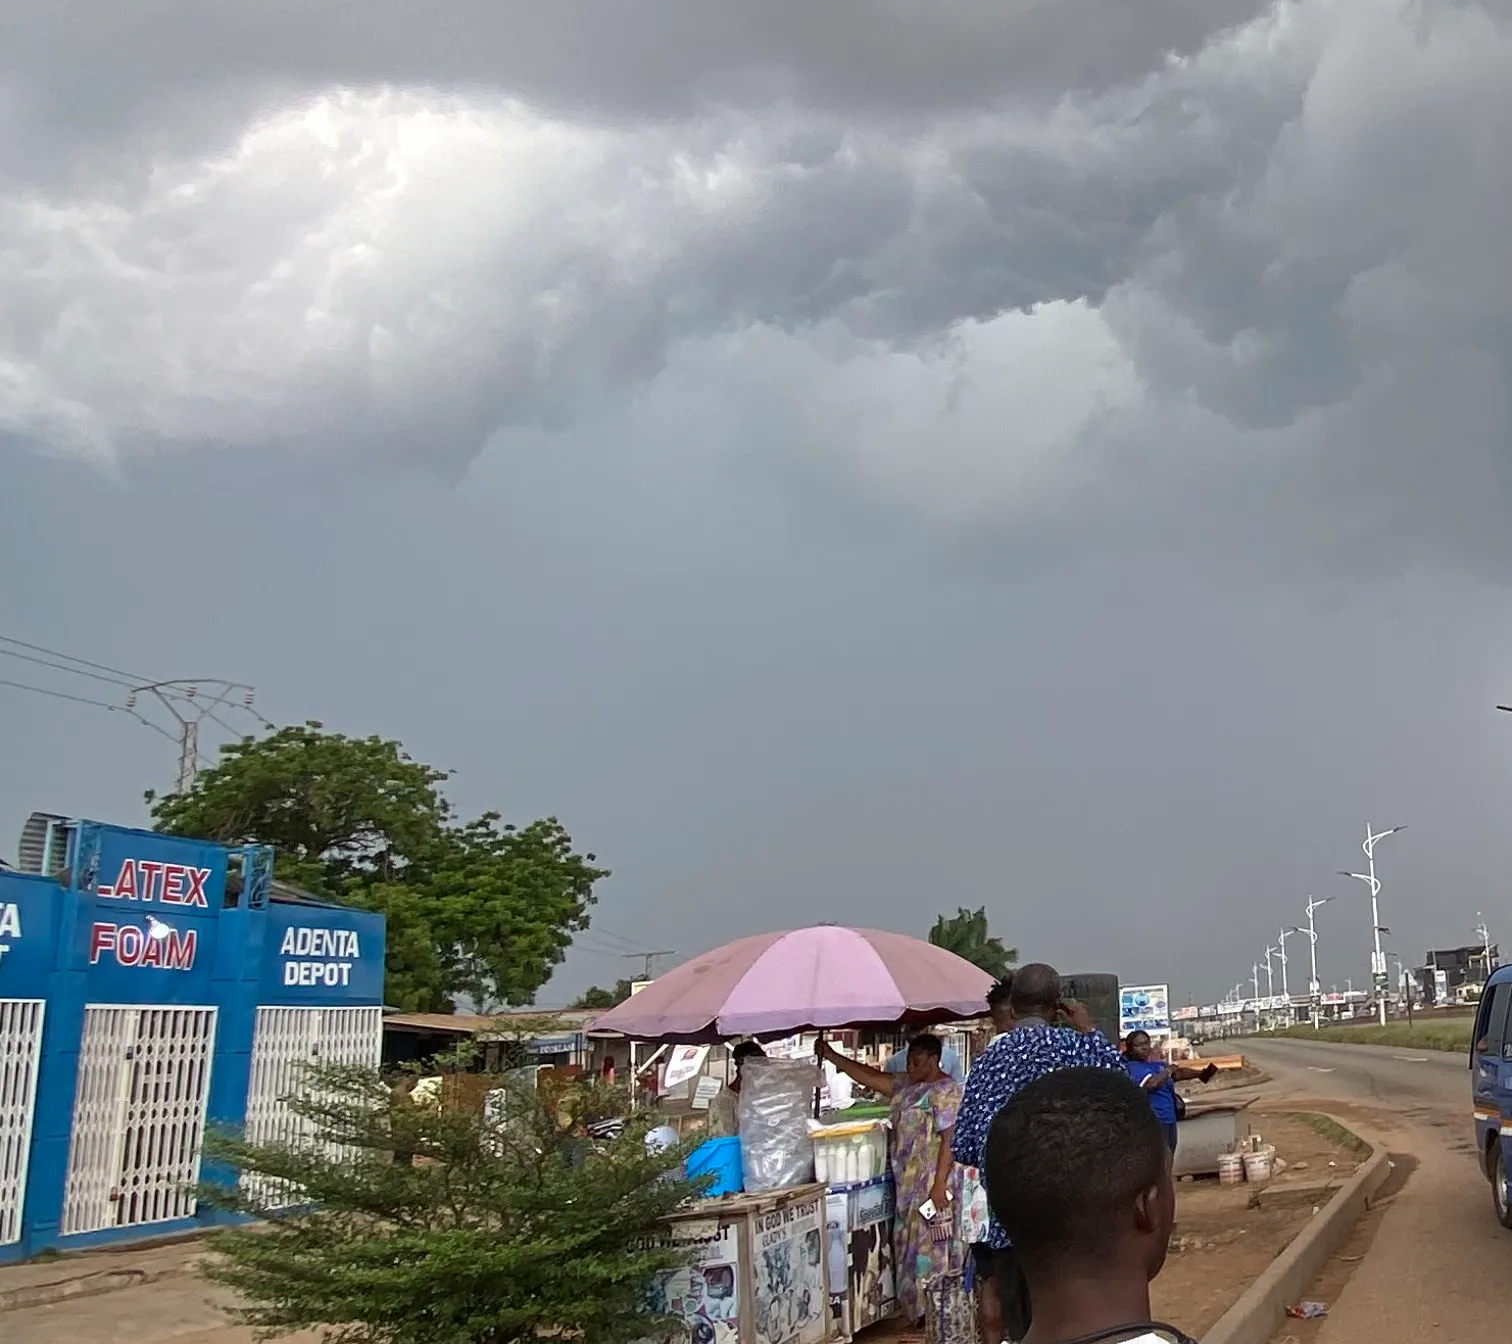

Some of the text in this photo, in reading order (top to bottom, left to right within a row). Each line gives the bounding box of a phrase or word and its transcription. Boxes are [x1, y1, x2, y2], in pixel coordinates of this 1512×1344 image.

[89, 922, 197, 971] FOAM
[280, 926, 360, 958] ADENTA
[284, 961, 352, 987] DEPOT
